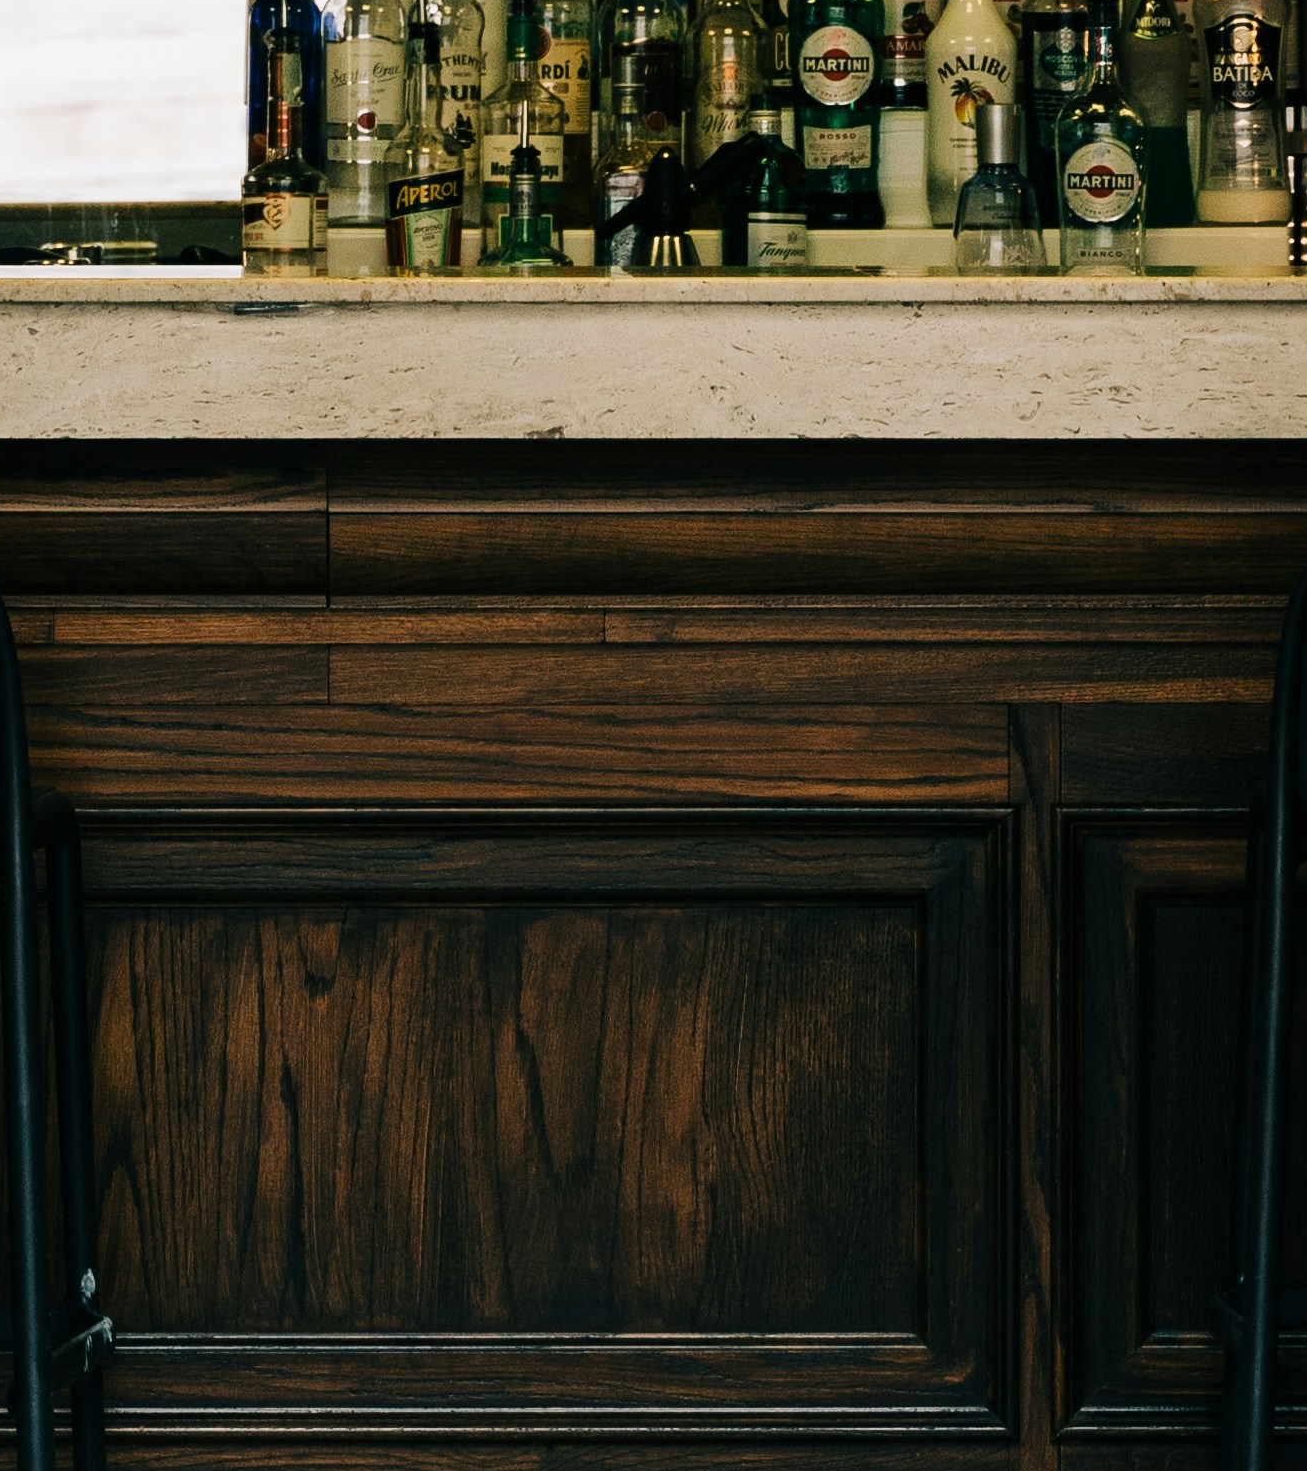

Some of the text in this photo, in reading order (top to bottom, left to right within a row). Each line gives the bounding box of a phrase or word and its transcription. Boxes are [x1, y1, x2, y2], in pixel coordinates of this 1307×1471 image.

[1135, 16, 1172, 28] MIDORI
[804, 57, 870, 73] MARTINI
[937, 54, 1012, 84] MALIBU
[1212, 65, 1273, 83] BATIDA
[819, 132, 858, 141] ROSSO
[1069, 173, 1133, 189] MARTINI
[396, 179, 458, 210] APEROL
[1079, 249, 1123, 259] BIANCO
